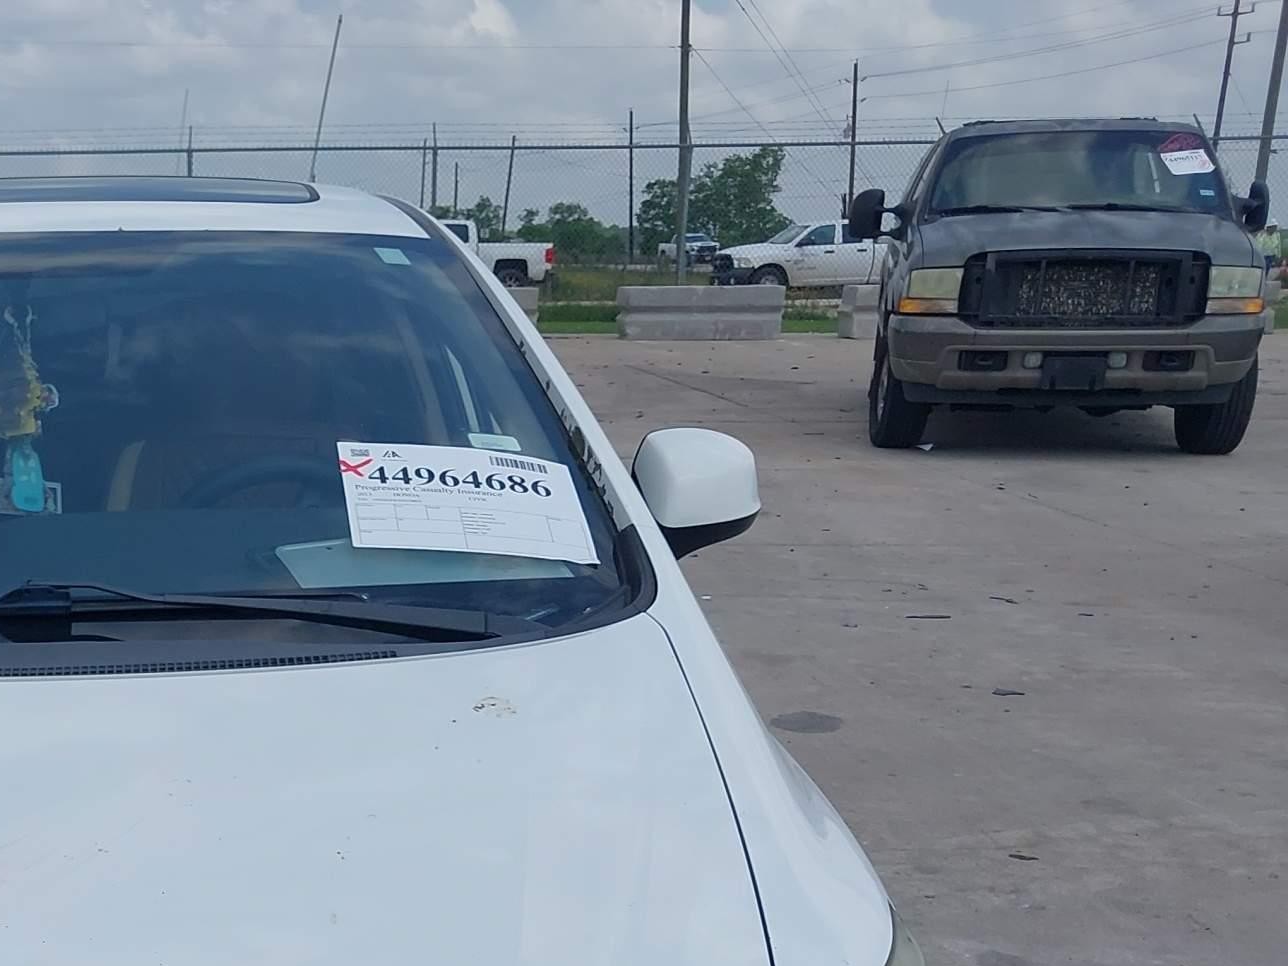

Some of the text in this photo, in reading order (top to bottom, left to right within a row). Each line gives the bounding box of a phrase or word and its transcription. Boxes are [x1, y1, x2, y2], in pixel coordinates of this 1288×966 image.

[368, 466, 552, 497] 44964686
[413, 487, 454, 495] Casualty
[457, 487, 503, 497] Insurance
